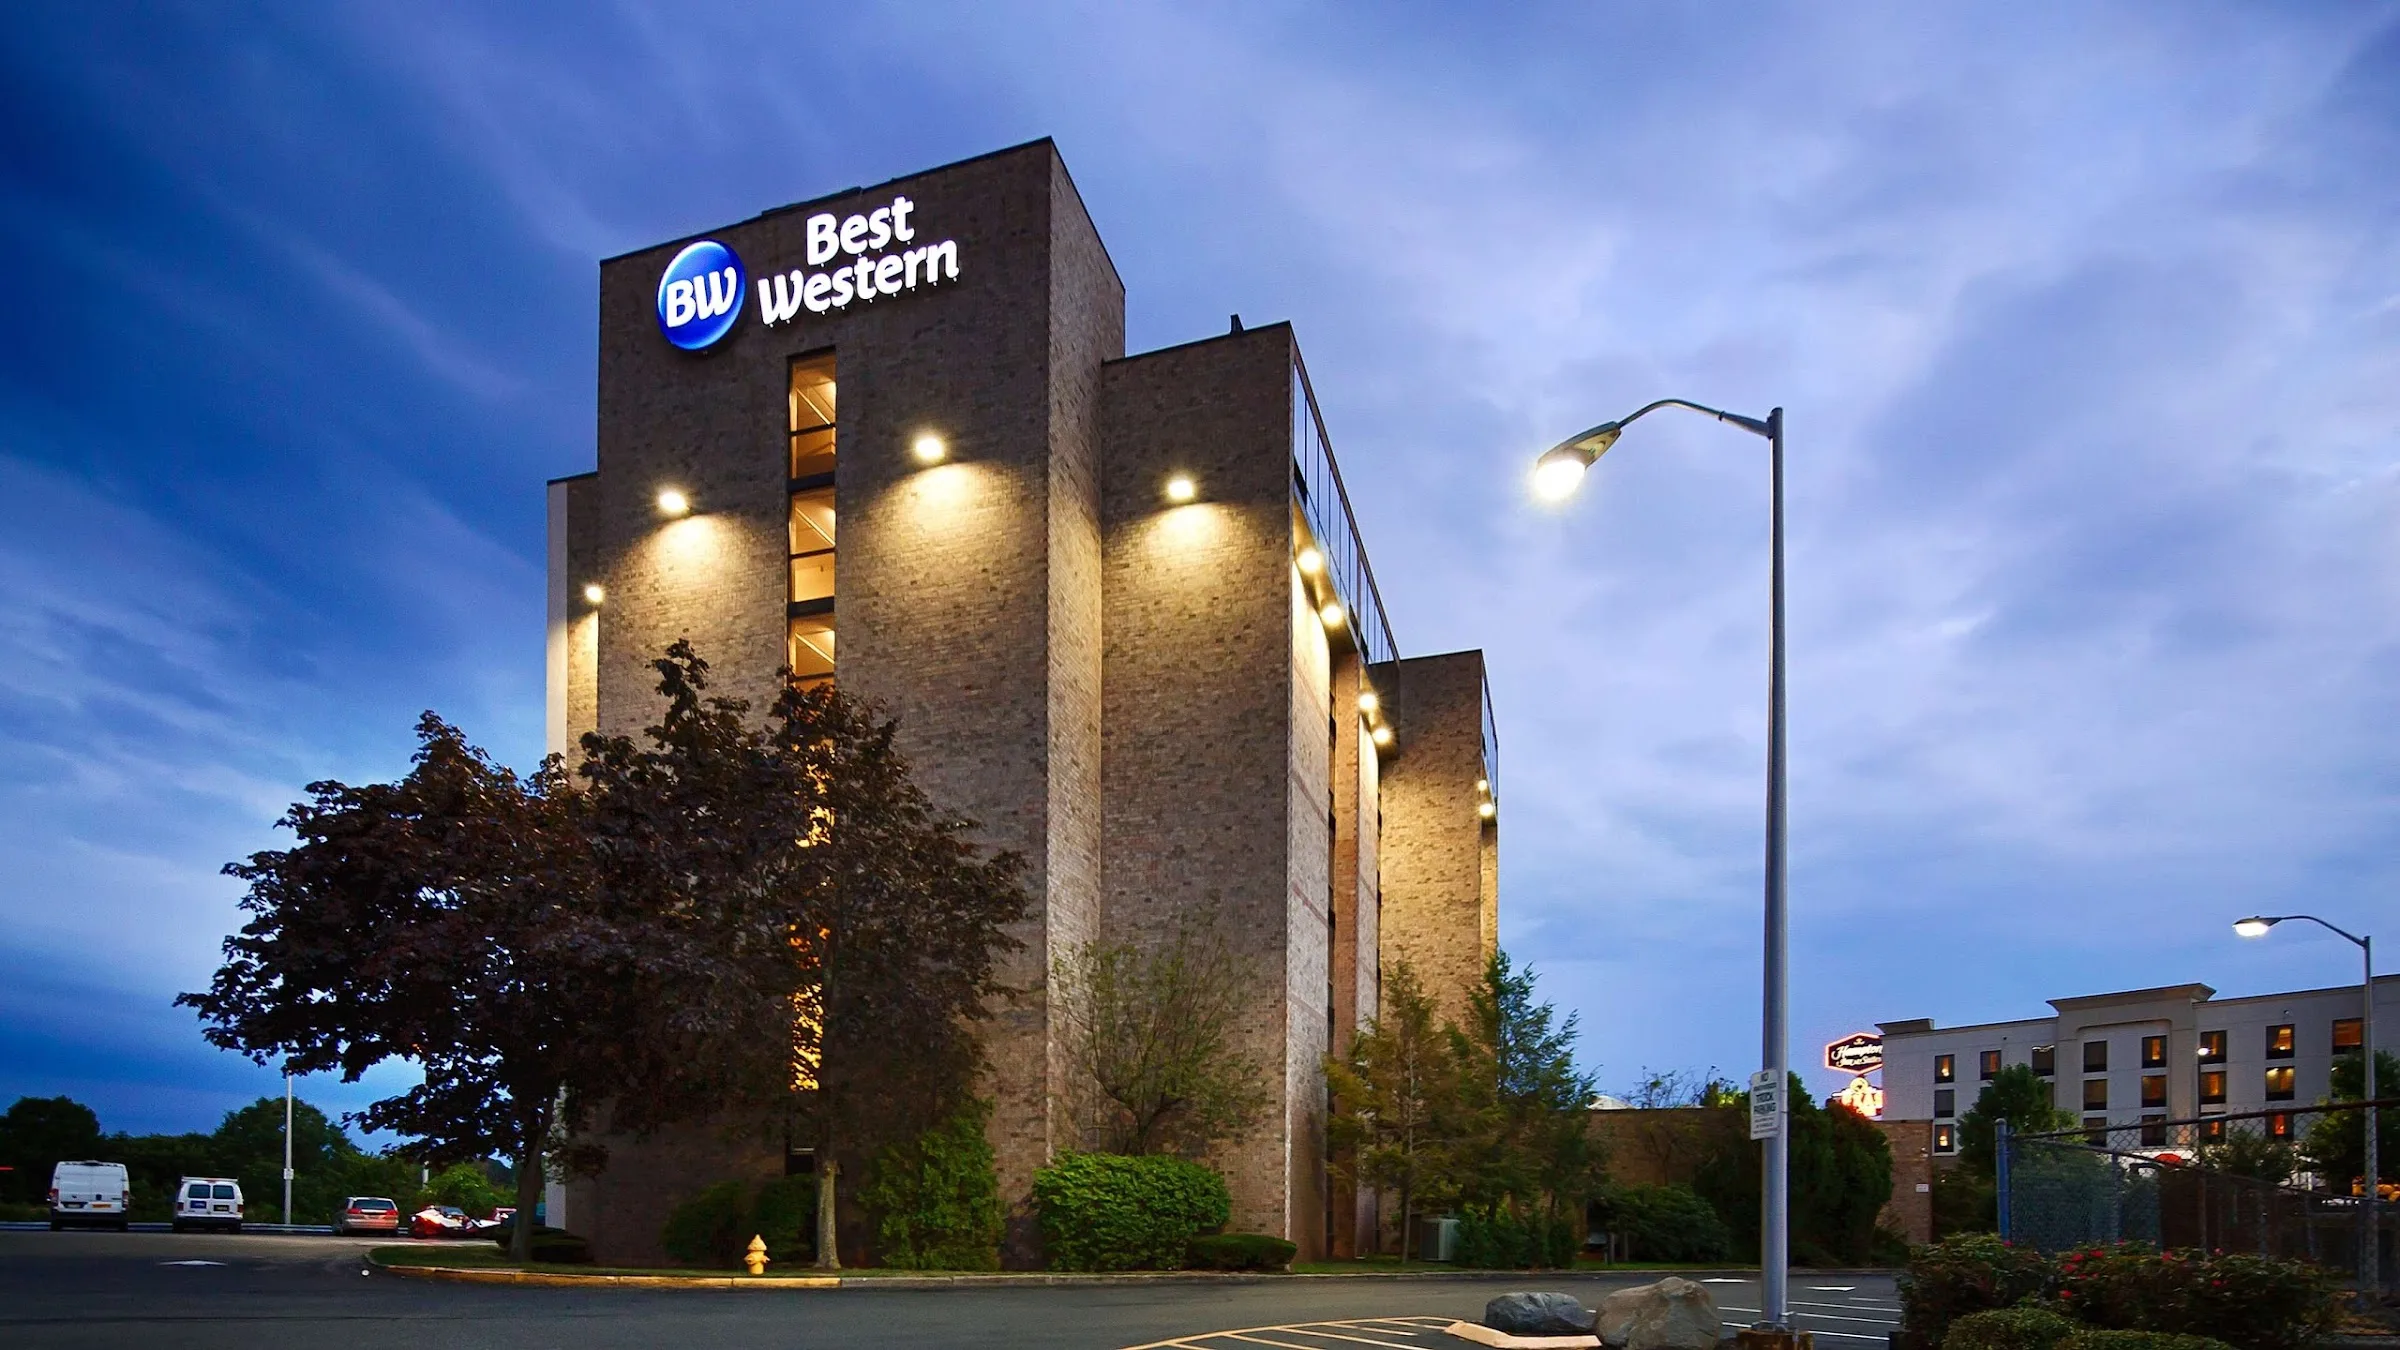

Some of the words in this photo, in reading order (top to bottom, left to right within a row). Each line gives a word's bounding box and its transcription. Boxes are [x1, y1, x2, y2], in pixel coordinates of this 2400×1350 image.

[806, 196, 915, 265] Best
[667, 266, 736, 328] BW
[758, 240, 960, 325] Western
[1831, 1044, 1883, 1060] Hampton
